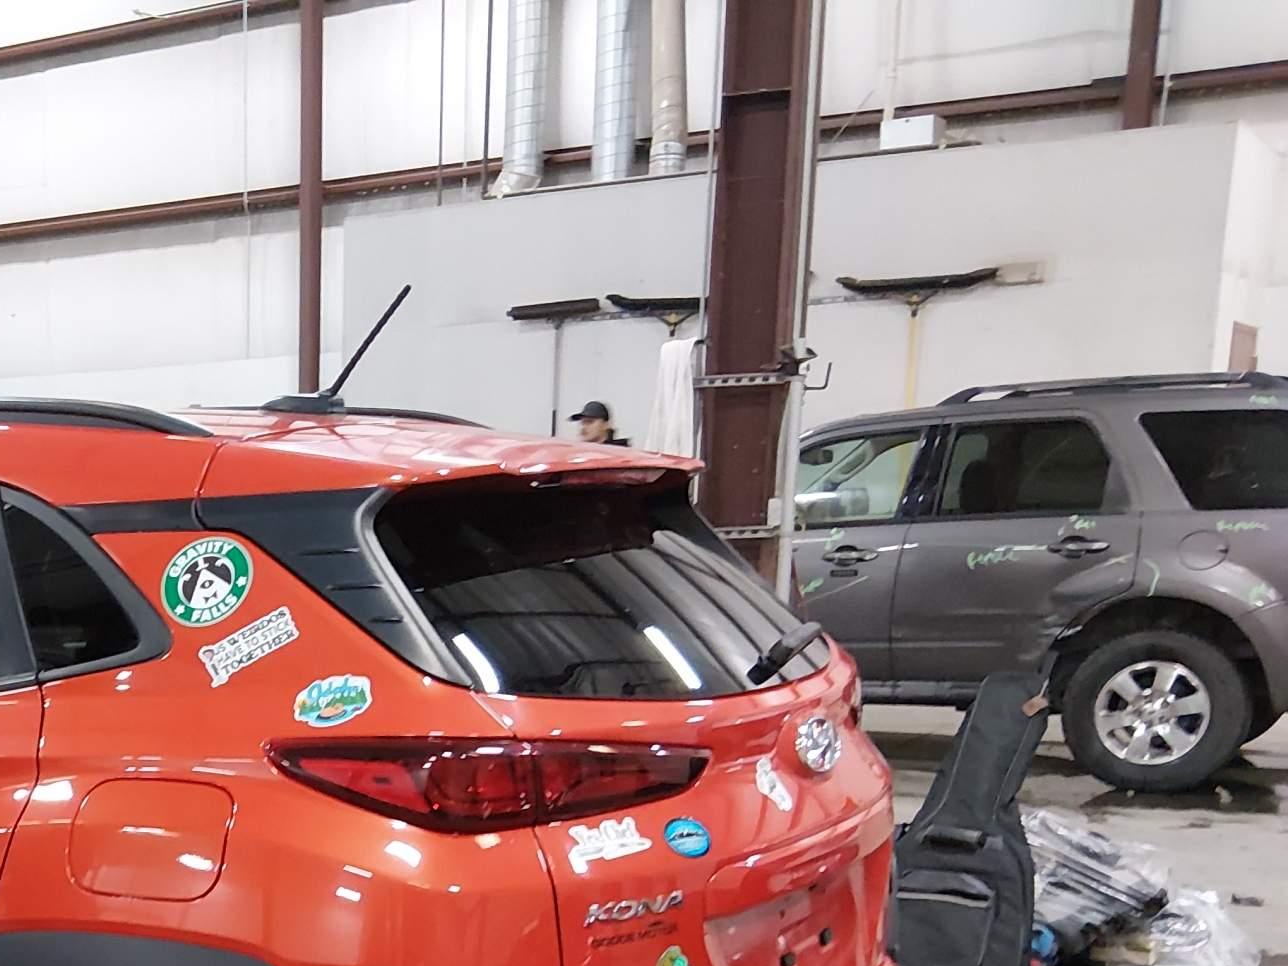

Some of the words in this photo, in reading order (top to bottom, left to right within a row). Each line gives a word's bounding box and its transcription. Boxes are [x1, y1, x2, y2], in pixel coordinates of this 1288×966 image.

[168, 541, 234, 578] GRAVITY
[190, 593, 238, 622] FALLS
[221, 630, 295, 674] TOGETHER
[245, 637, 260, 649] TO
[583, 889, 683, 928] KONA
